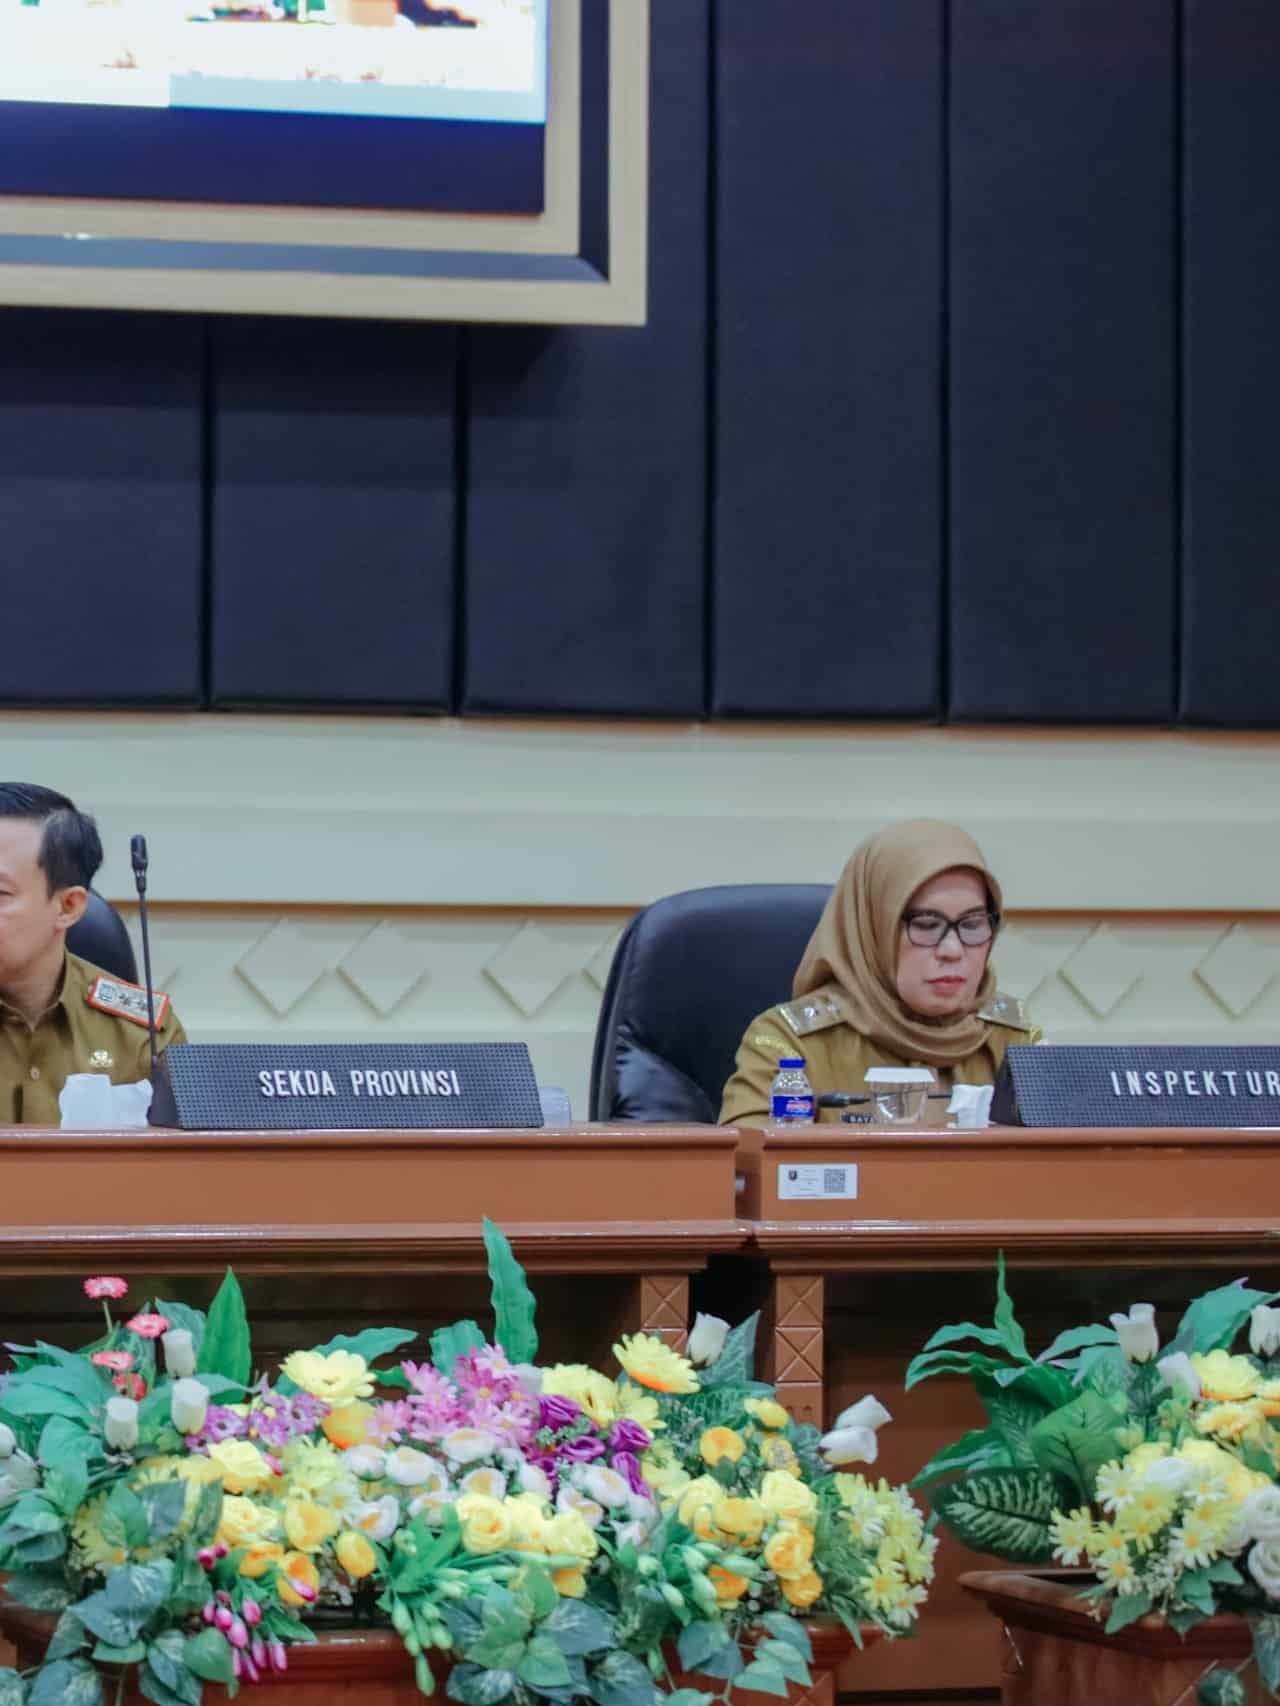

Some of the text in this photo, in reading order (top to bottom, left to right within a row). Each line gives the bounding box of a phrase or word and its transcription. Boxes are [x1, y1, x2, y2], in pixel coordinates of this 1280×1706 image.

[258, 1069, 461, 1097] SEKDA PROVINSI
[1110, 1070, 1280, 1096] INSPEKTUR
